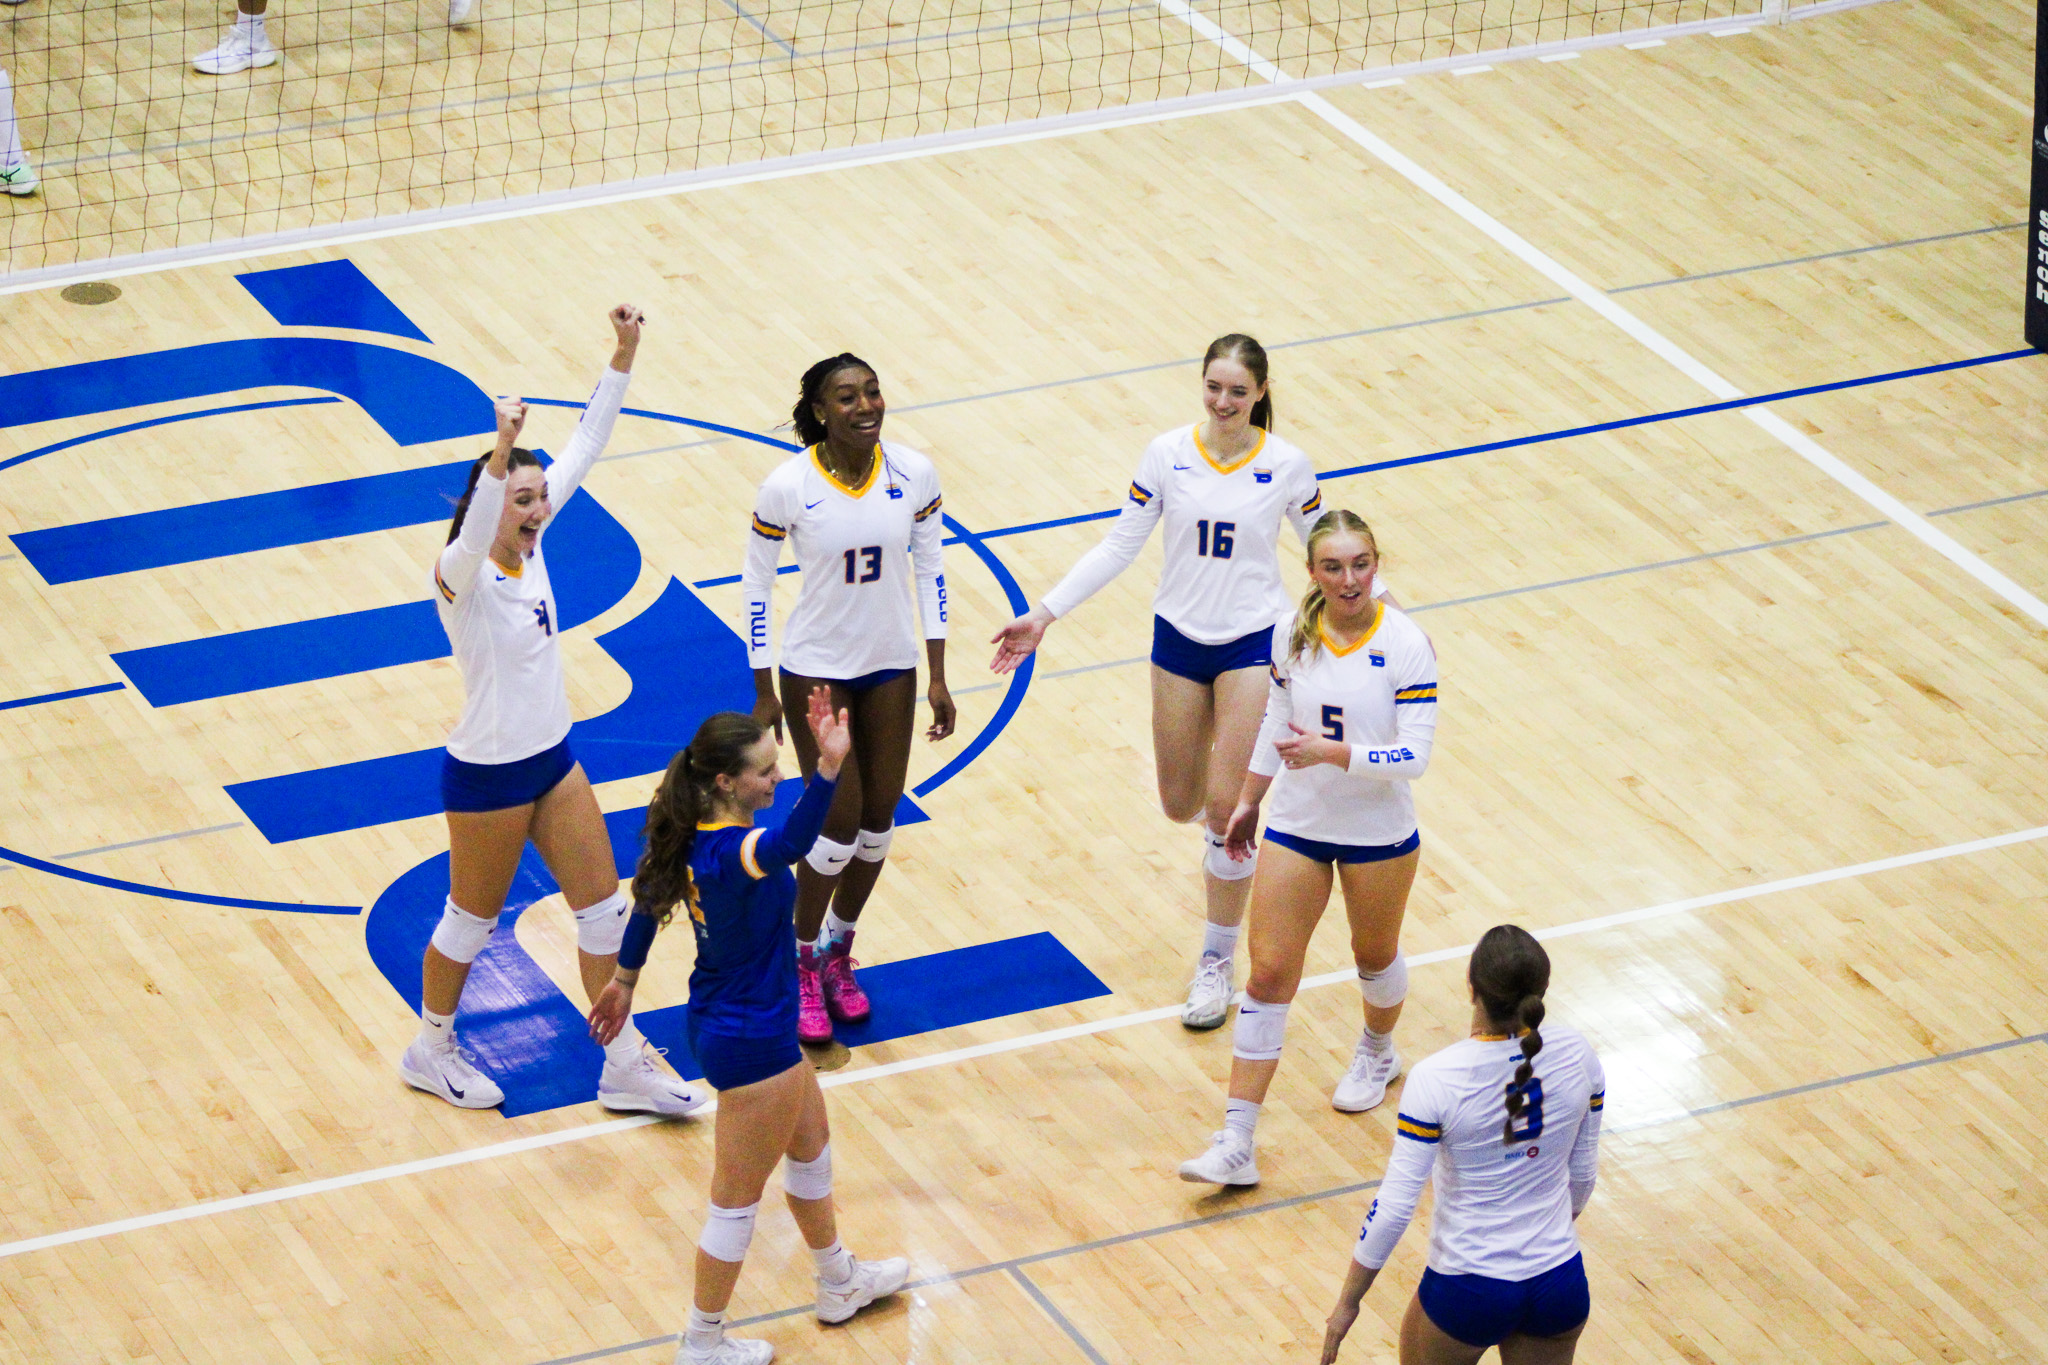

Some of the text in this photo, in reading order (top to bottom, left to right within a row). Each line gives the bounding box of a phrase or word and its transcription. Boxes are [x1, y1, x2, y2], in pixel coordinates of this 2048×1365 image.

[1197, 519, 1236, 560] 16
[843, 545, 883, 584] 13
[935, 573, 948, 623] BOLD
[533, 600, 553, 637] 4
[750, 601, 767, 652] TMU
[1321, 704, 1344, 742] 5
[1368, 747, 1416, 764] BOLD
